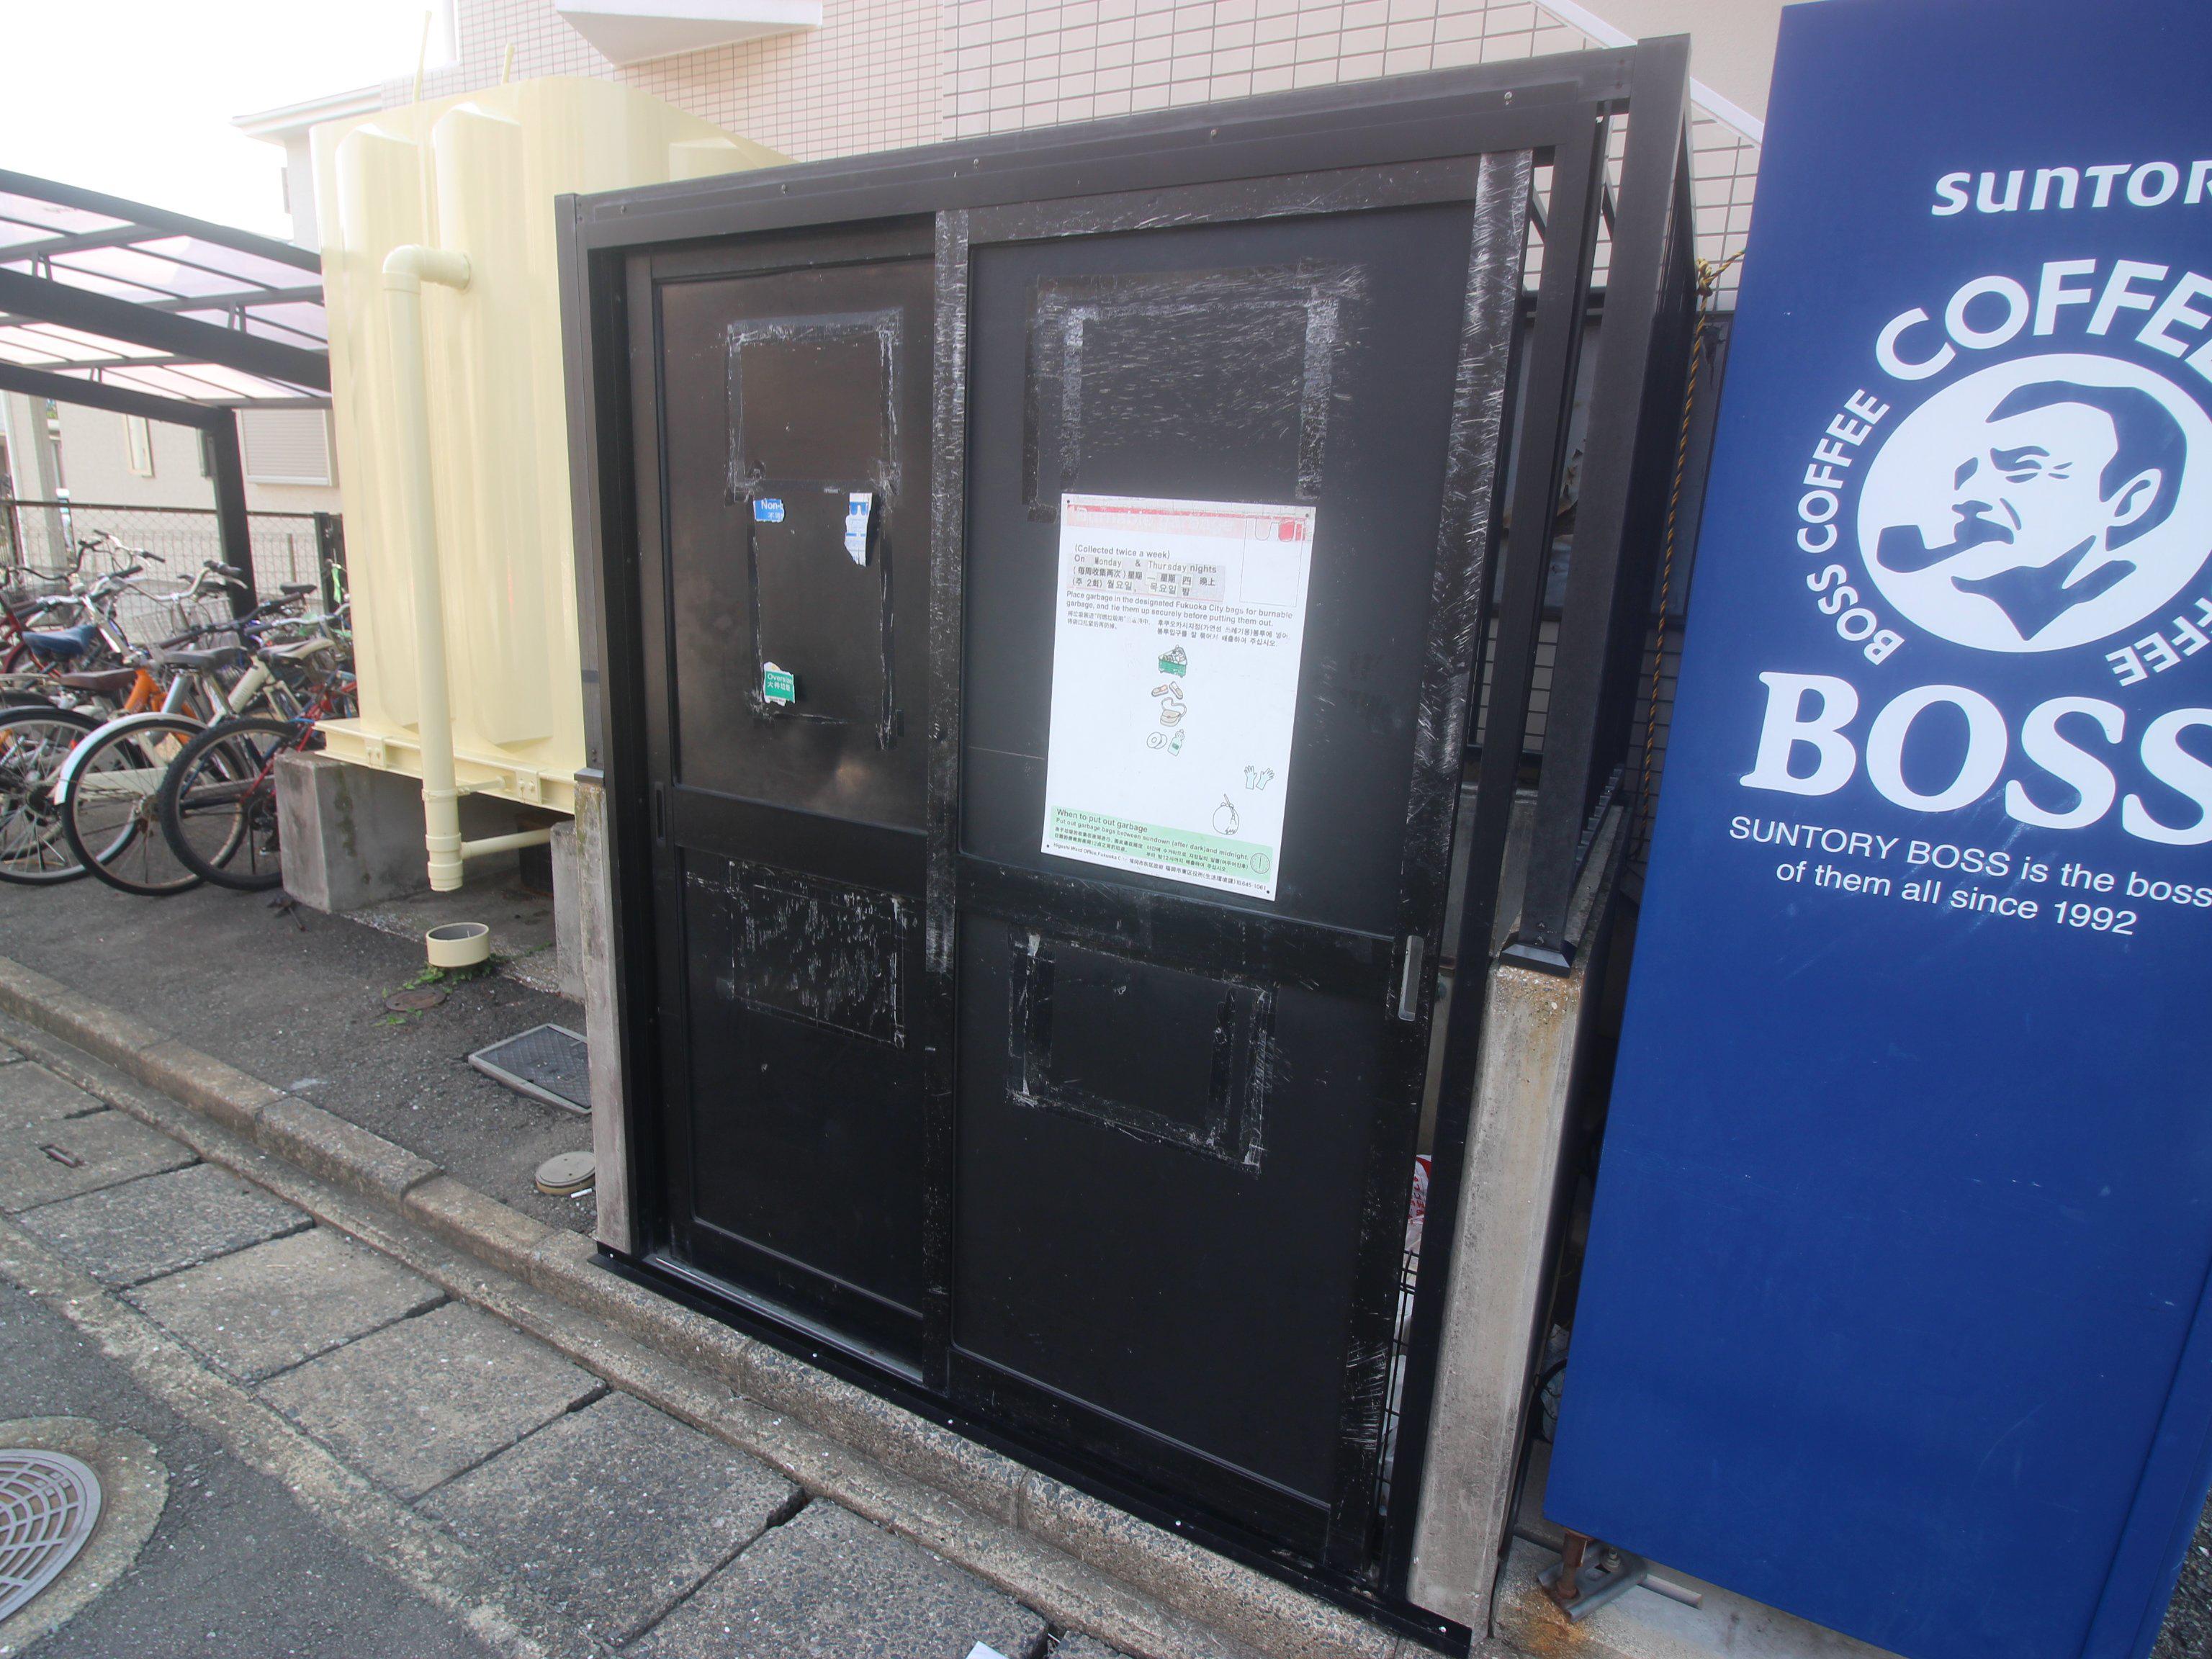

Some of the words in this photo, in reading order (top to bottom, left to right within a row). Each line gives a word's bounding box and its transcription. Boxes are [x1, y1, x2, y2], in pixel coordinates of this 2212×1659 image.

[1797, 388, 1891, 554] COFFEE
[1074, 544, 1114, 554] (Collected
[1116, 548, 1137, 557] twice
[1146, 550, 1170, 559] week)
[1094, 557, 1122, 567] Monday
[1148, 560, 1187, 572] Thursday
[1190, 565, 1217, 574] nights
[1066, 600, 1094, 610] garbage,
[1151, 608, 1182, 619] securely
[1184, 611, 1208, 620] before
[1209, 614, 1236, 624] putting
[1086, 593, 1112, 602] garbage
[1135, 597, 1174, 607] designated
[1176, 601, 1207, 611] Fukuoka
[1209, 603, 1223, 613] City
[1226, 606, 1244, 615] bags
[1259, 608, 1292, 619] burnable
[1806, 564, 1905, 665] BOSS
[1739, 671, 2212, 845] BOSS
[1056, 808, 1077, 819] When
[1089, 814, 1101, 824] put
[1103, 817, 1115, 826] out
[1117, 820, 1148, 833] garbage
[1053, 842, 1070, 852] Higashi
[1077, 821, 1100, 832] garbage
[1102, 825, 1115, 835] bags
[1117, 829, 1141, 840] between
[1143, 834, 1170, 845] sundown
[1172, 840, 1188, 849] (after
[1219, 850, 1249, 860] midnight.
[1730, 815, 1899, 860] SUNTORY
[1907, 840, 2011, 876] BOSS
[2020, 856, 2049, 883] is
[2061, 863, 2116, 892] the
[2126, 871, 2212, 907] boss
[1776, 860, 1807, 883] of
[1815, 864, 1891, 896] them
[1901, 879, 1941, 904] all
[1950, 886, 2038, 920] since
[2054, 901, 2137, 935] 1992
